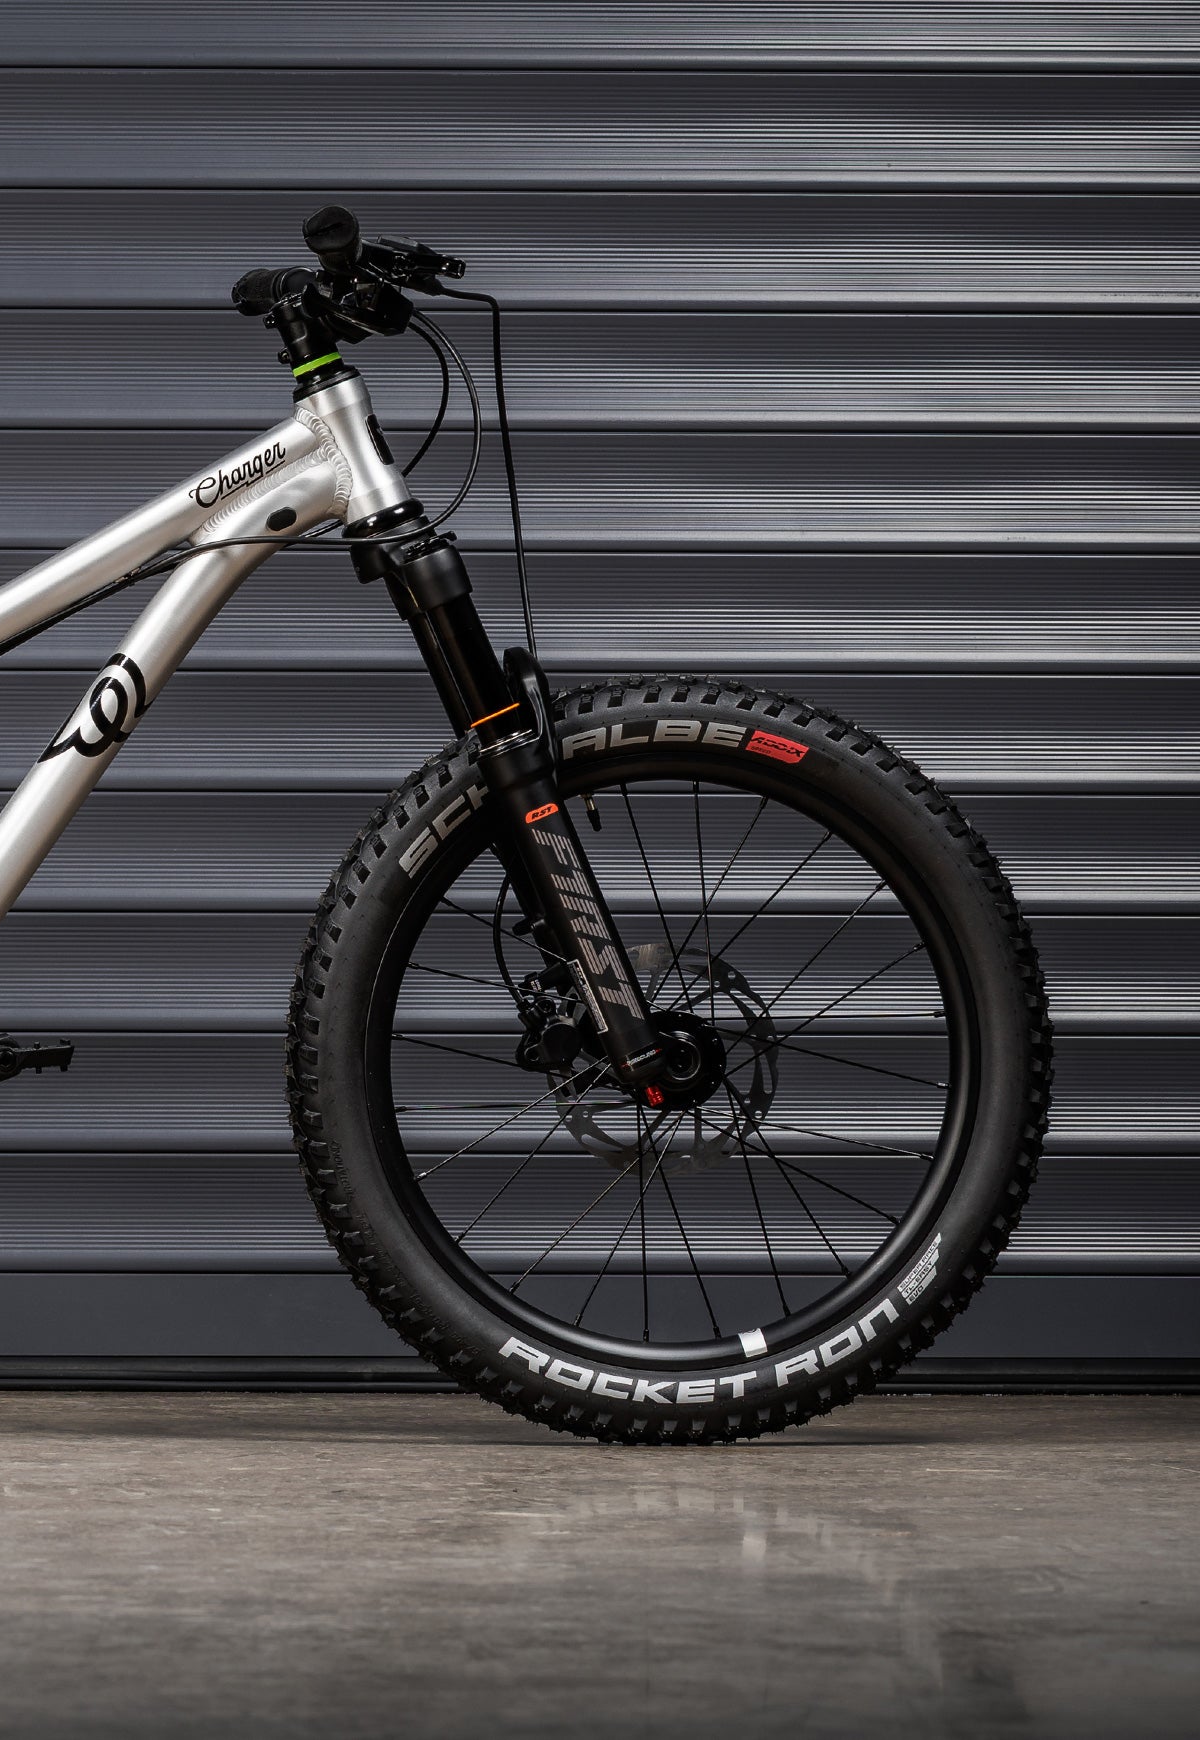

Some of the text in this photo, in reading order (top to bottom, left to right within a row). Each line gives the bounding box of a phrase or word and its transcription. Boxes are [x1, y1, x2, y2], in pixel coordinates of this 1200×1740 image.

[189, 442, 286, 508] Charger
[399, 719, 747, 879] SCALBE
[531, 805, 553, 820] RST
[532, 828, 645, 1020] FIRST
[909, 1285, 924, 1301] EVO
[499, 1298, 899, 1404] ROCKET RON
